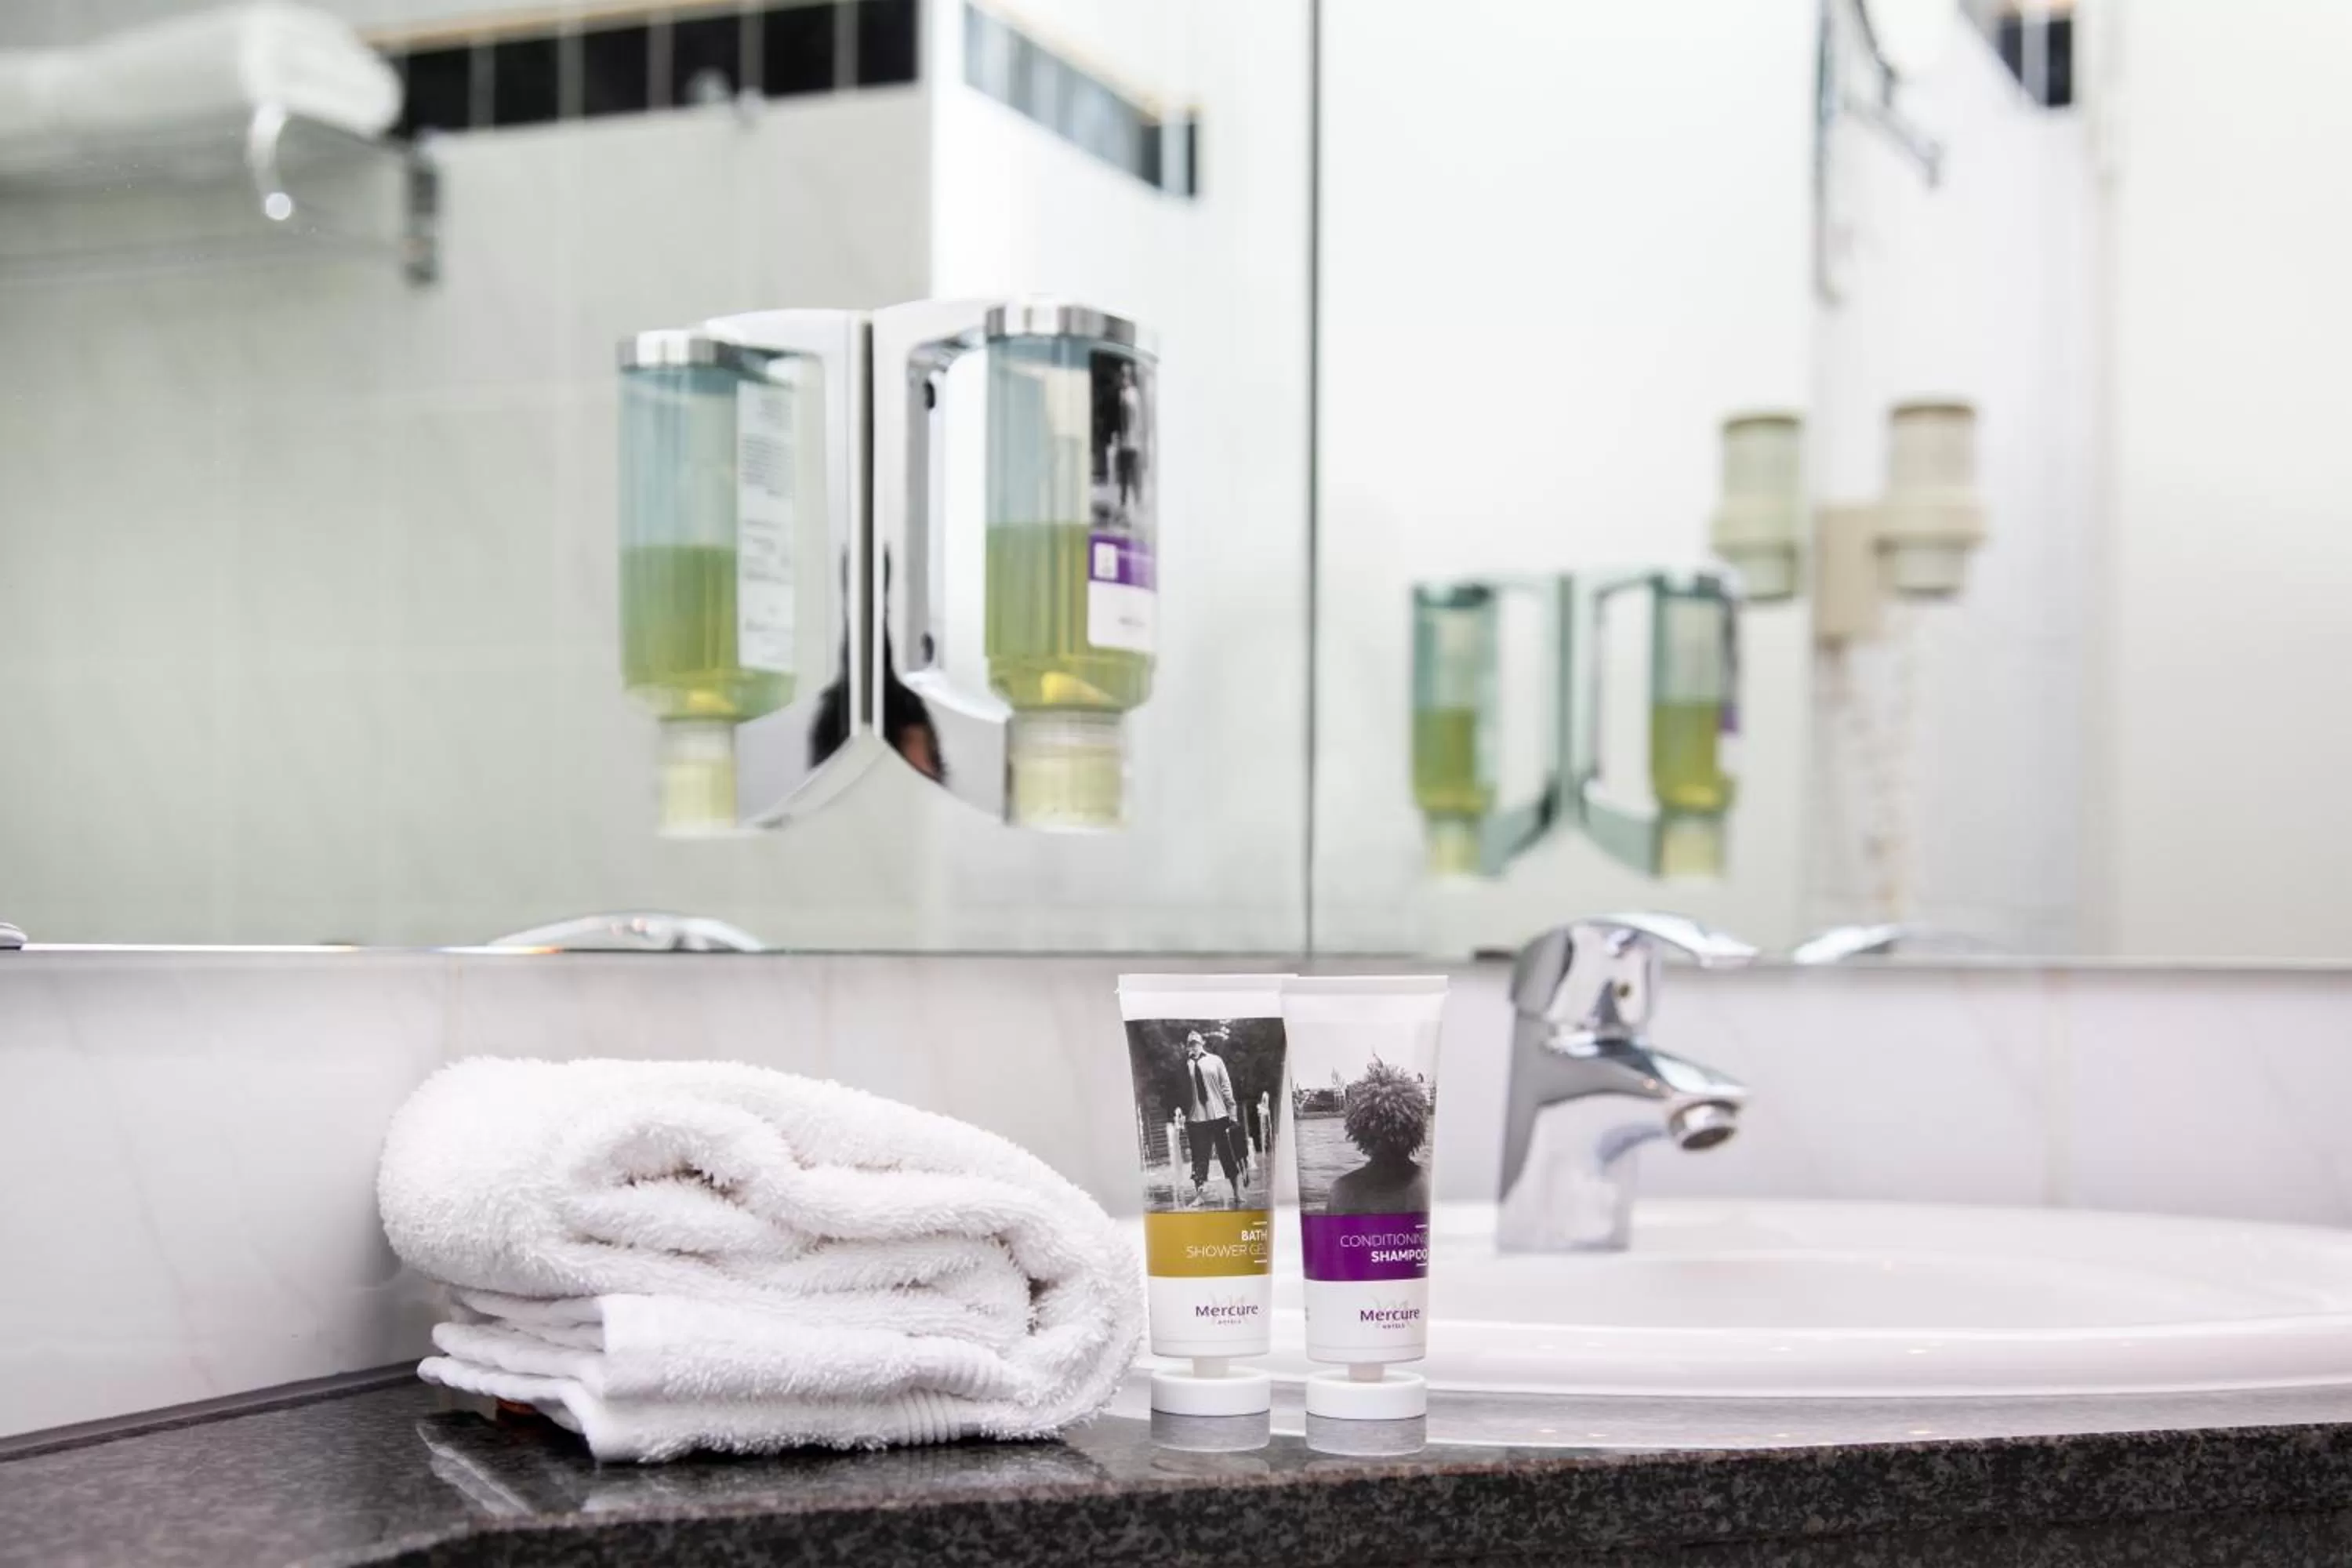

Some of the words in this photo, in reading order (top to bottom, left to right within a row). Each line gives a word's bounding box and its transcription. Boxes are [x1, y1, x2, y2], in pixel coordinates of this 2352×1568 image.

[1241, 1229, 1267, 1241] BATH
[1186, 1243, 1247, 1258] SHOWER
[1370, 1248, 1427, 1263] SHAMPOO
[1195, 1305, 1259, 1317] Mercure
[1359, 1308, 1420, 1322] Mercure
